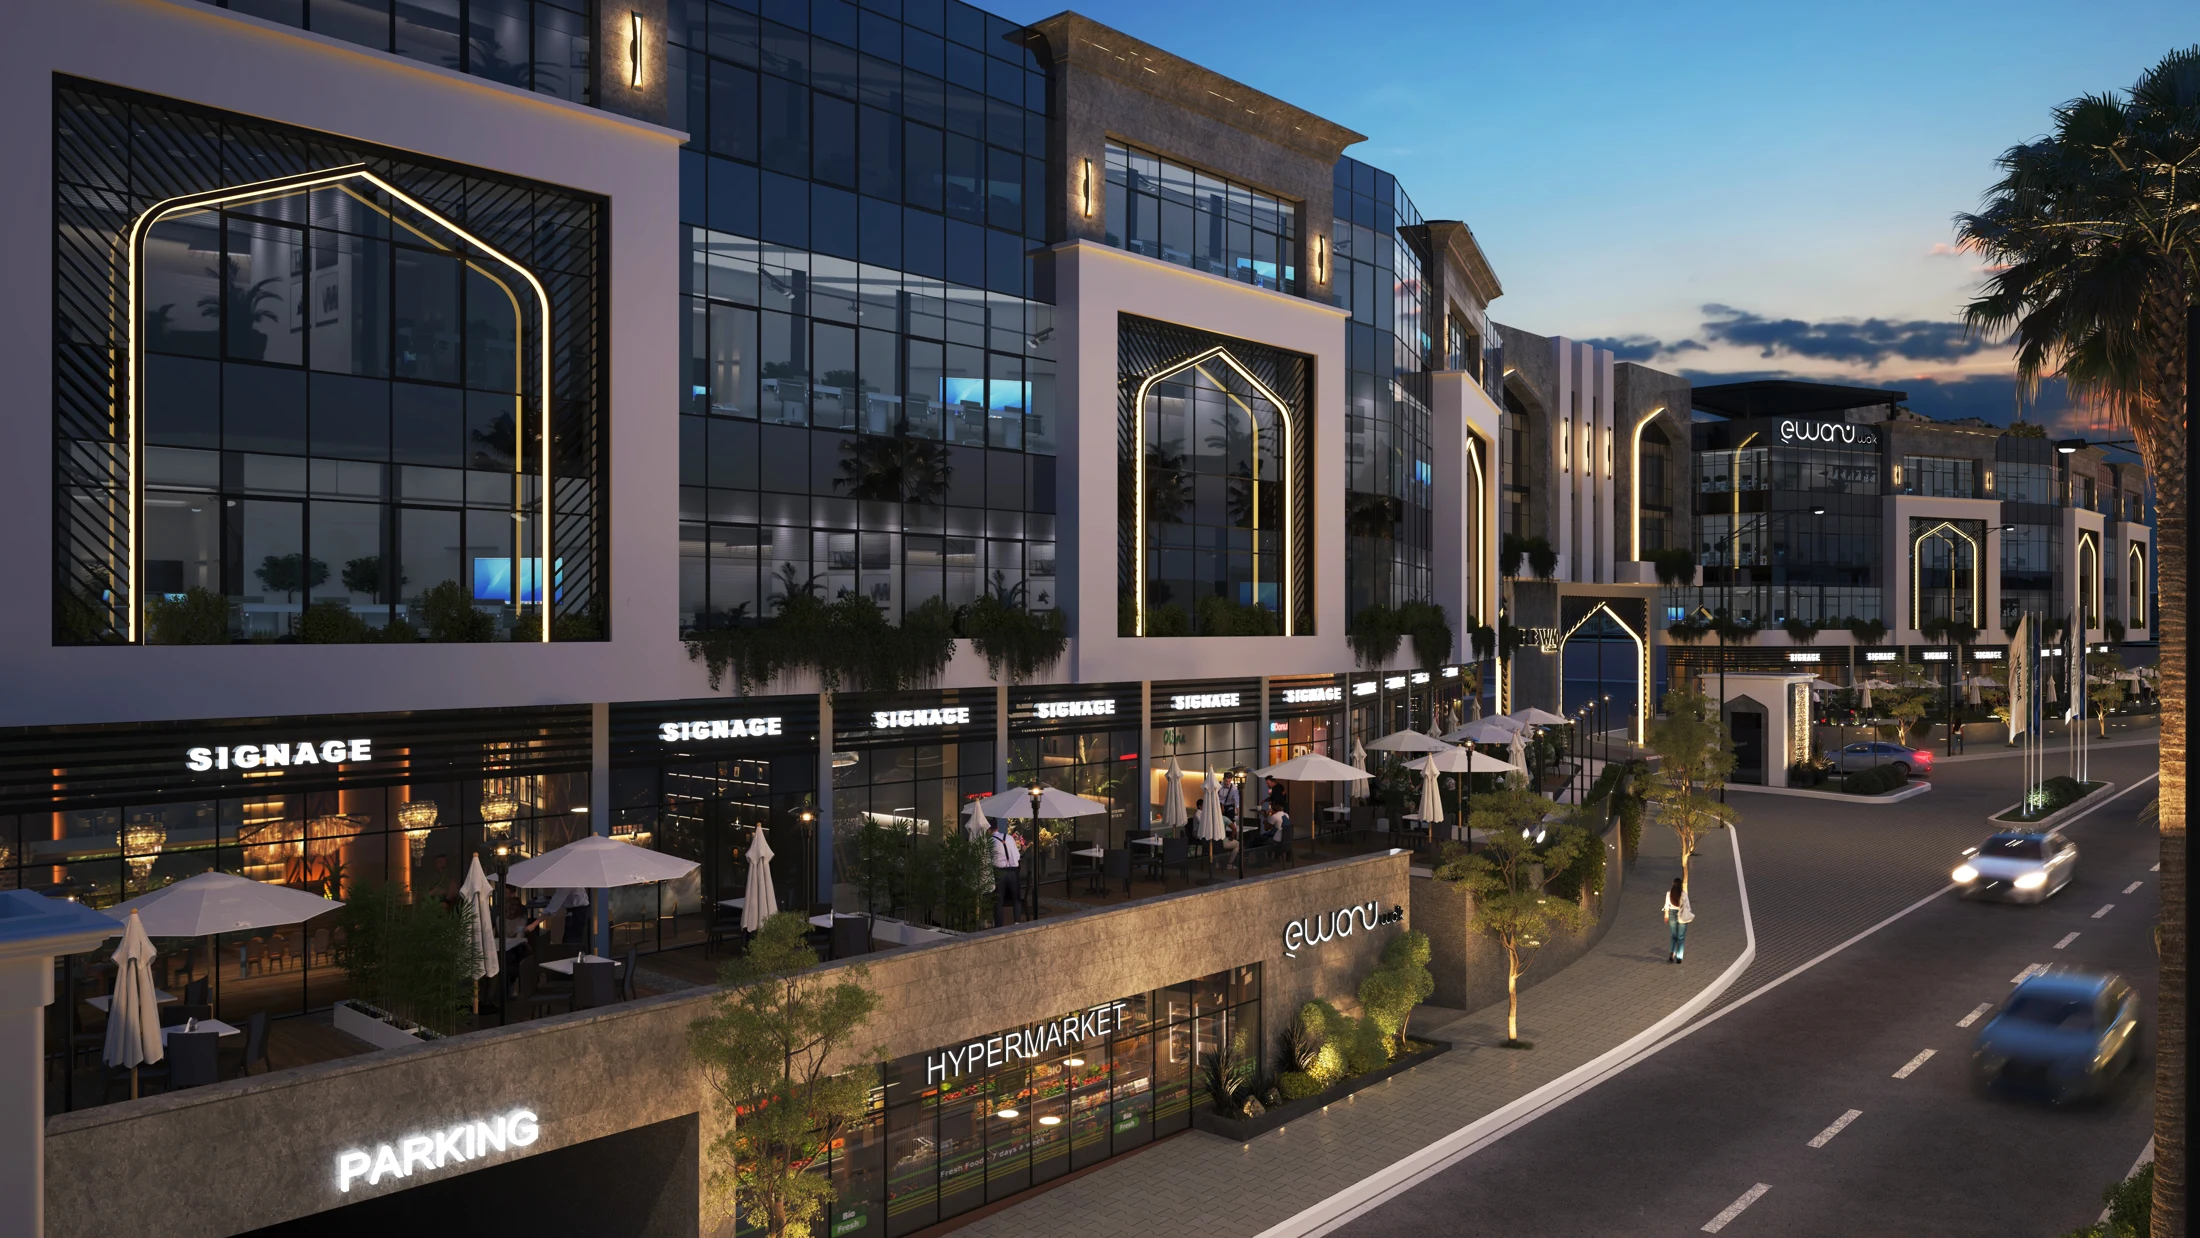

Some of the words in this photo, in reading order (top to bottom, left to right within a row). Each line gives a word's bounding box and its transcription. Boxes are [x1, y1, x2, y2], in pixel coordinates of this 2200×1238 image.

[1789, 653, 1821, 662] SIGNAGE
[1867, 653, 1896, 661] SIGNAGE
[1173, 693, 1239, 710] SIGNAGE
[1286, 688, 1341, 703] SIGNAGE
[873, 707, 969, 729] SIGNAGE
[1036, 700, 1115, 719] SIGNAGE
[661, 717, 782, 742] SIGNAGE
[187, 739, 372, 771] SIGNAGE
[927, 1003, 1126, 1085] HYPERMARKET
[1119, 1121, 1135, 1131] Fresh
[338, 1109, 540, 1193] PARKING
[940, 1166, 963, 1178] Fresh
[965, 1158, 984, 1169] Food
[999, 1148, 1017, 1158] days
[842, 1210, 856, 1221] Bio
[837, 1220, 860, 1234] Fresh
